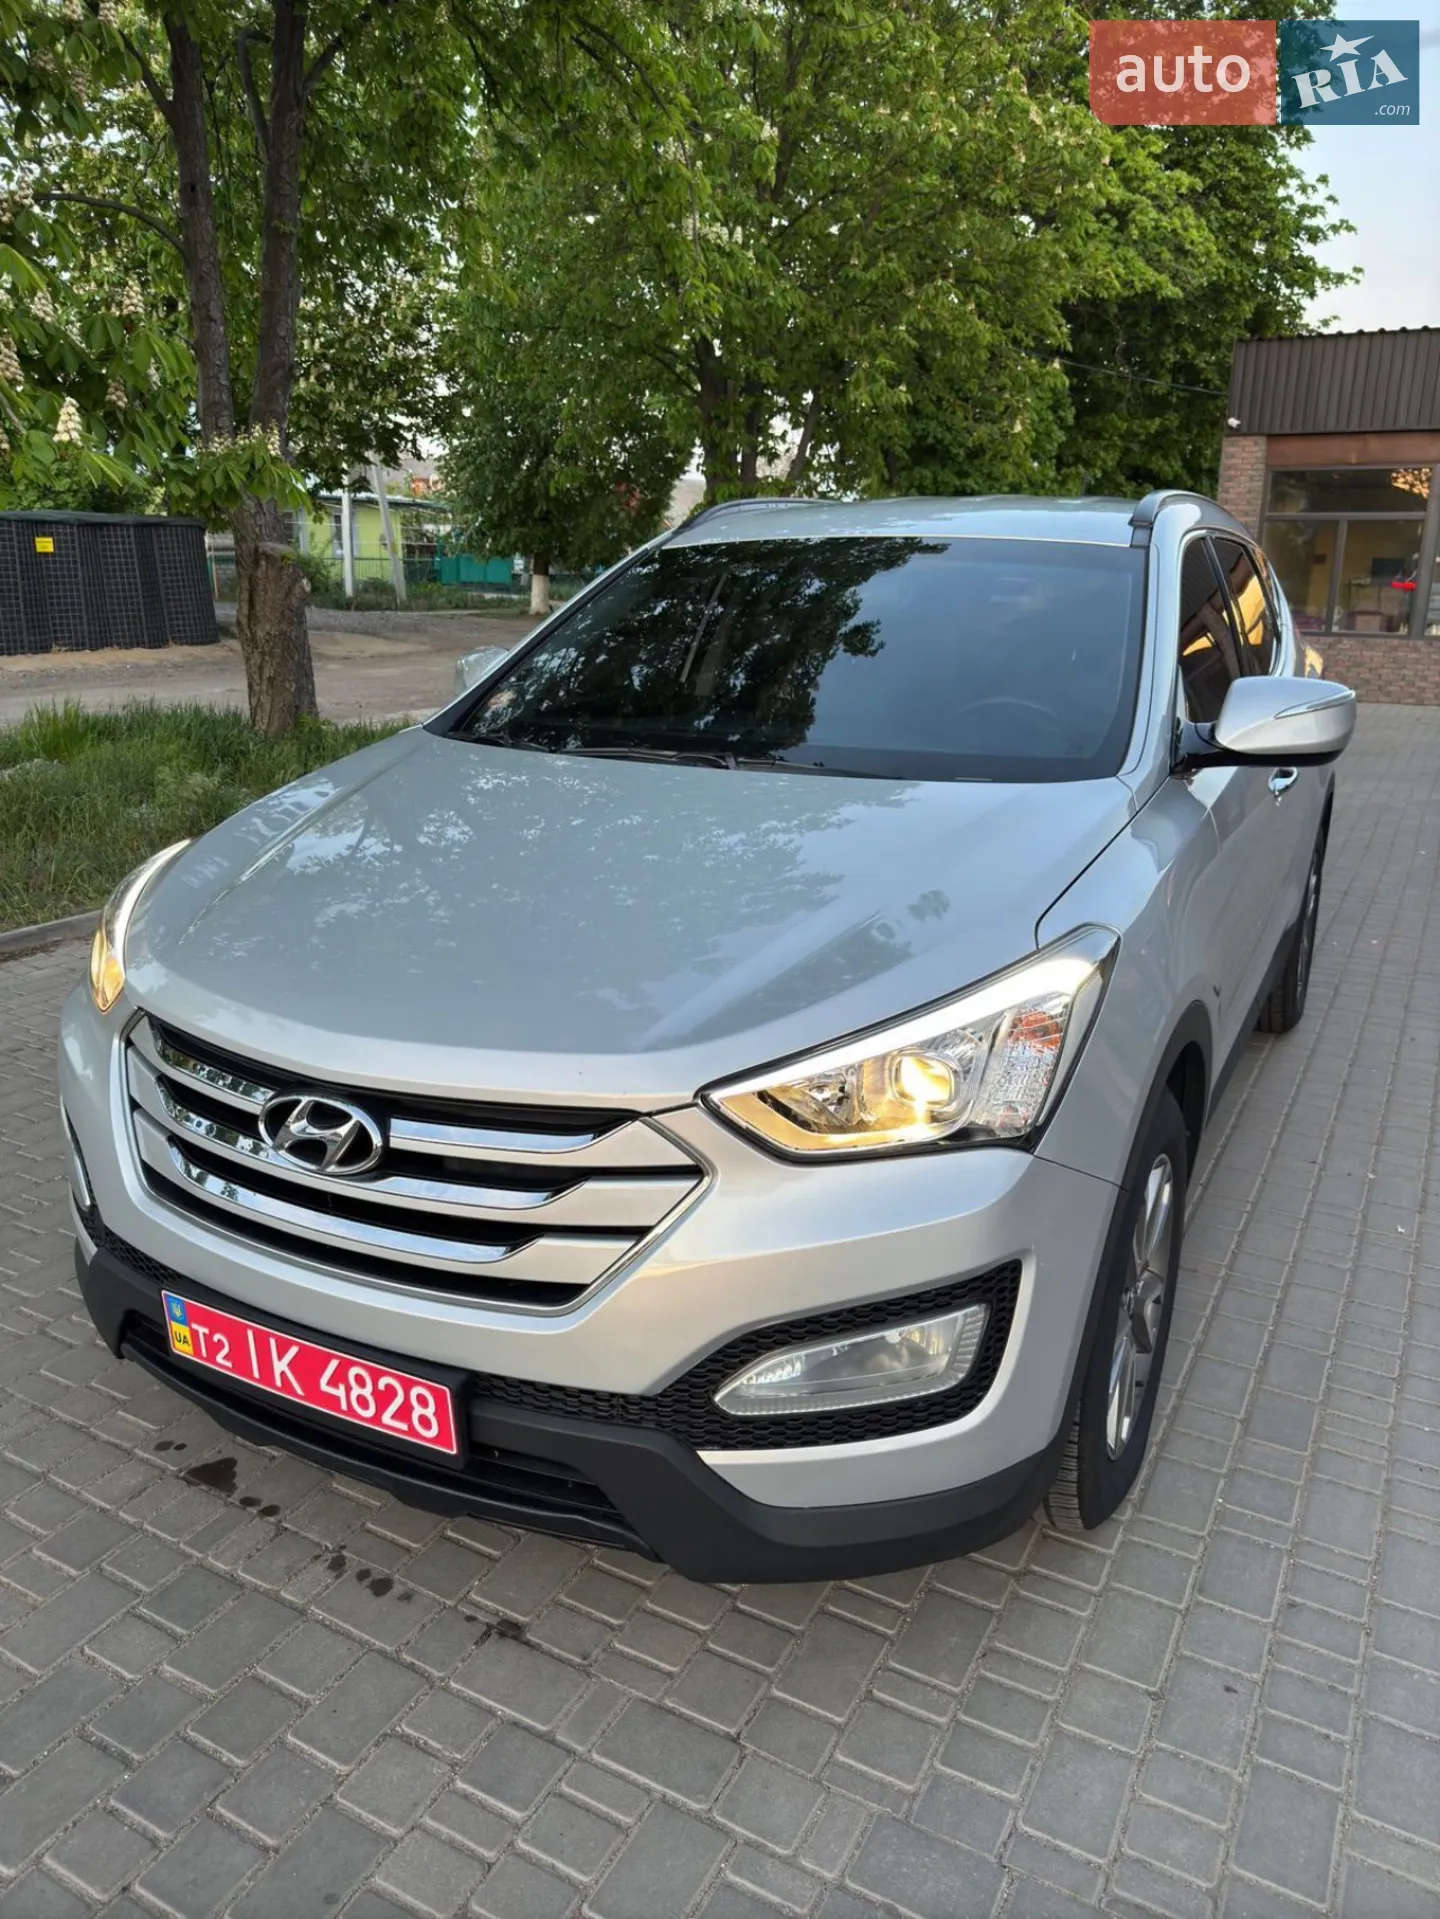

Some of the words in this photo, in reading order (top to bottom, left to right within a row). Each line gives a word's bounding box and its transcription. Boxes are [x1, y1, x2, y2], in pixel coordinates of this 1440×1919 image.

[174, 1331, 191, 1347] UA
[191, 1323, 233, 1368] T2
[246, 1329, 305, 1396] IK
[319, 1358, 440, 1438] 4828
